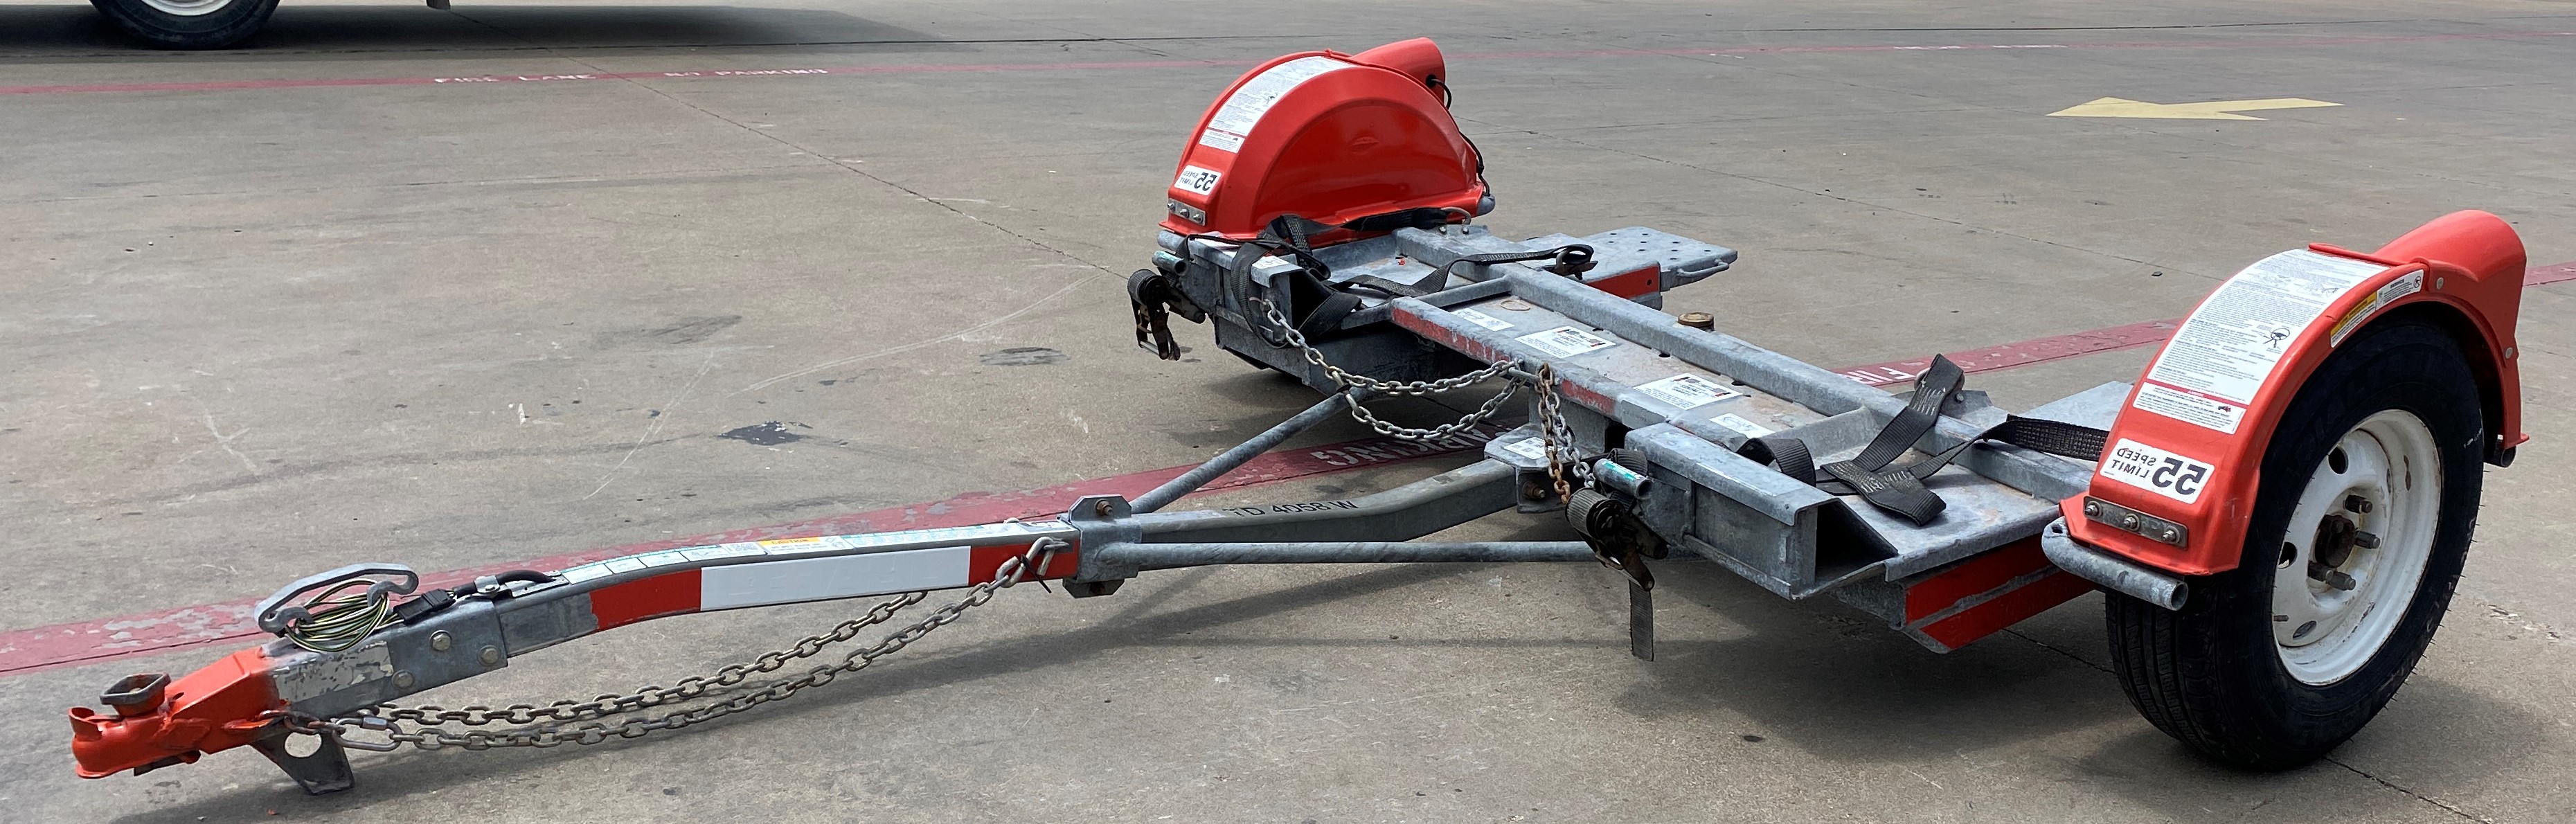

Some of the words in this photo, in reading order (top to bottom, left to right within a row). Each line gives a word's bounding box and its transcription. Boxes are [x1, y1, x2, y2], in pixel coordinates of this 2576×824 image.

[1835, 366, 1916, 384] FIR
[1309, 426, 1508, 467] ARKING
[1222, 506, 1266, 517] TD
[1271, 502, 1332, 514] 4058
[1329, 500, 1360, 510] W
